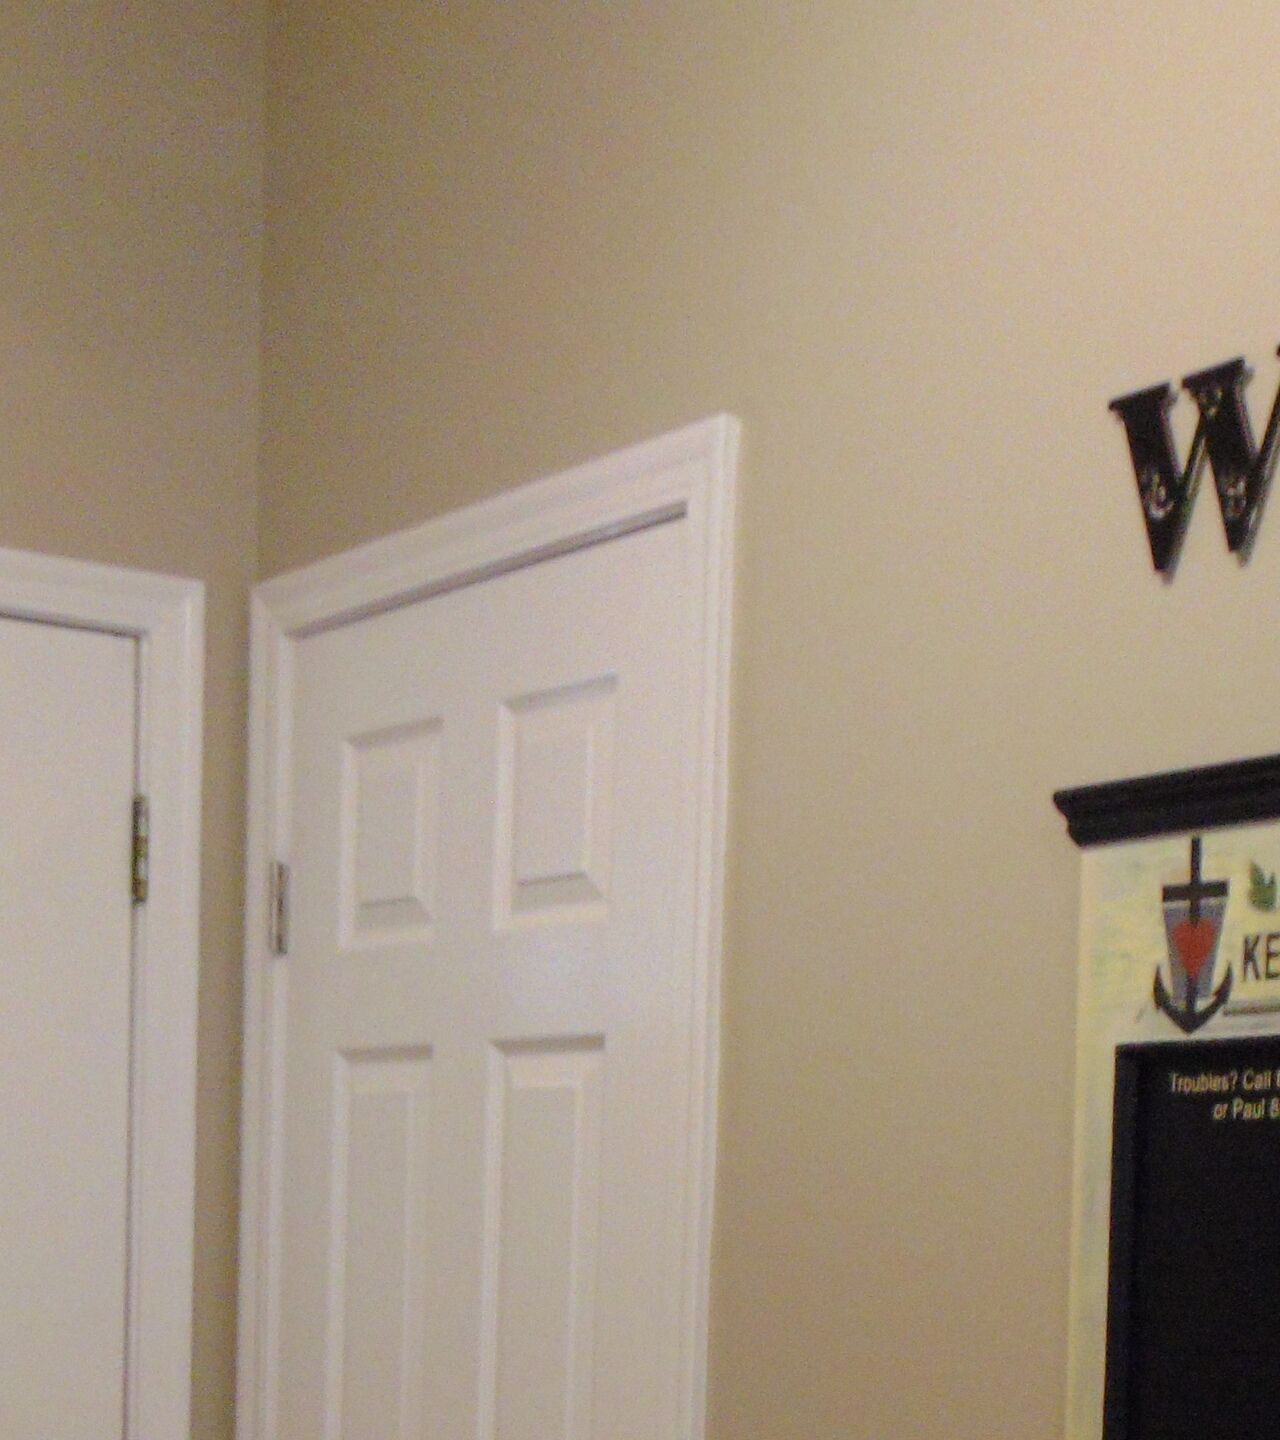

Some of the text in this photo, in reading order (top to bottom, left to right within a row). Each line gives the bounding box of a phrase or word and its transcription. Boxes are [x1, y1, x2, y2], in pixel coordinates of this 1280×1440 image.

[1242, 1068, 1272, 1091] Call
[1213, 1103, 1228, 1120] or
[1232, 1098, 1265, 1120] Paul
